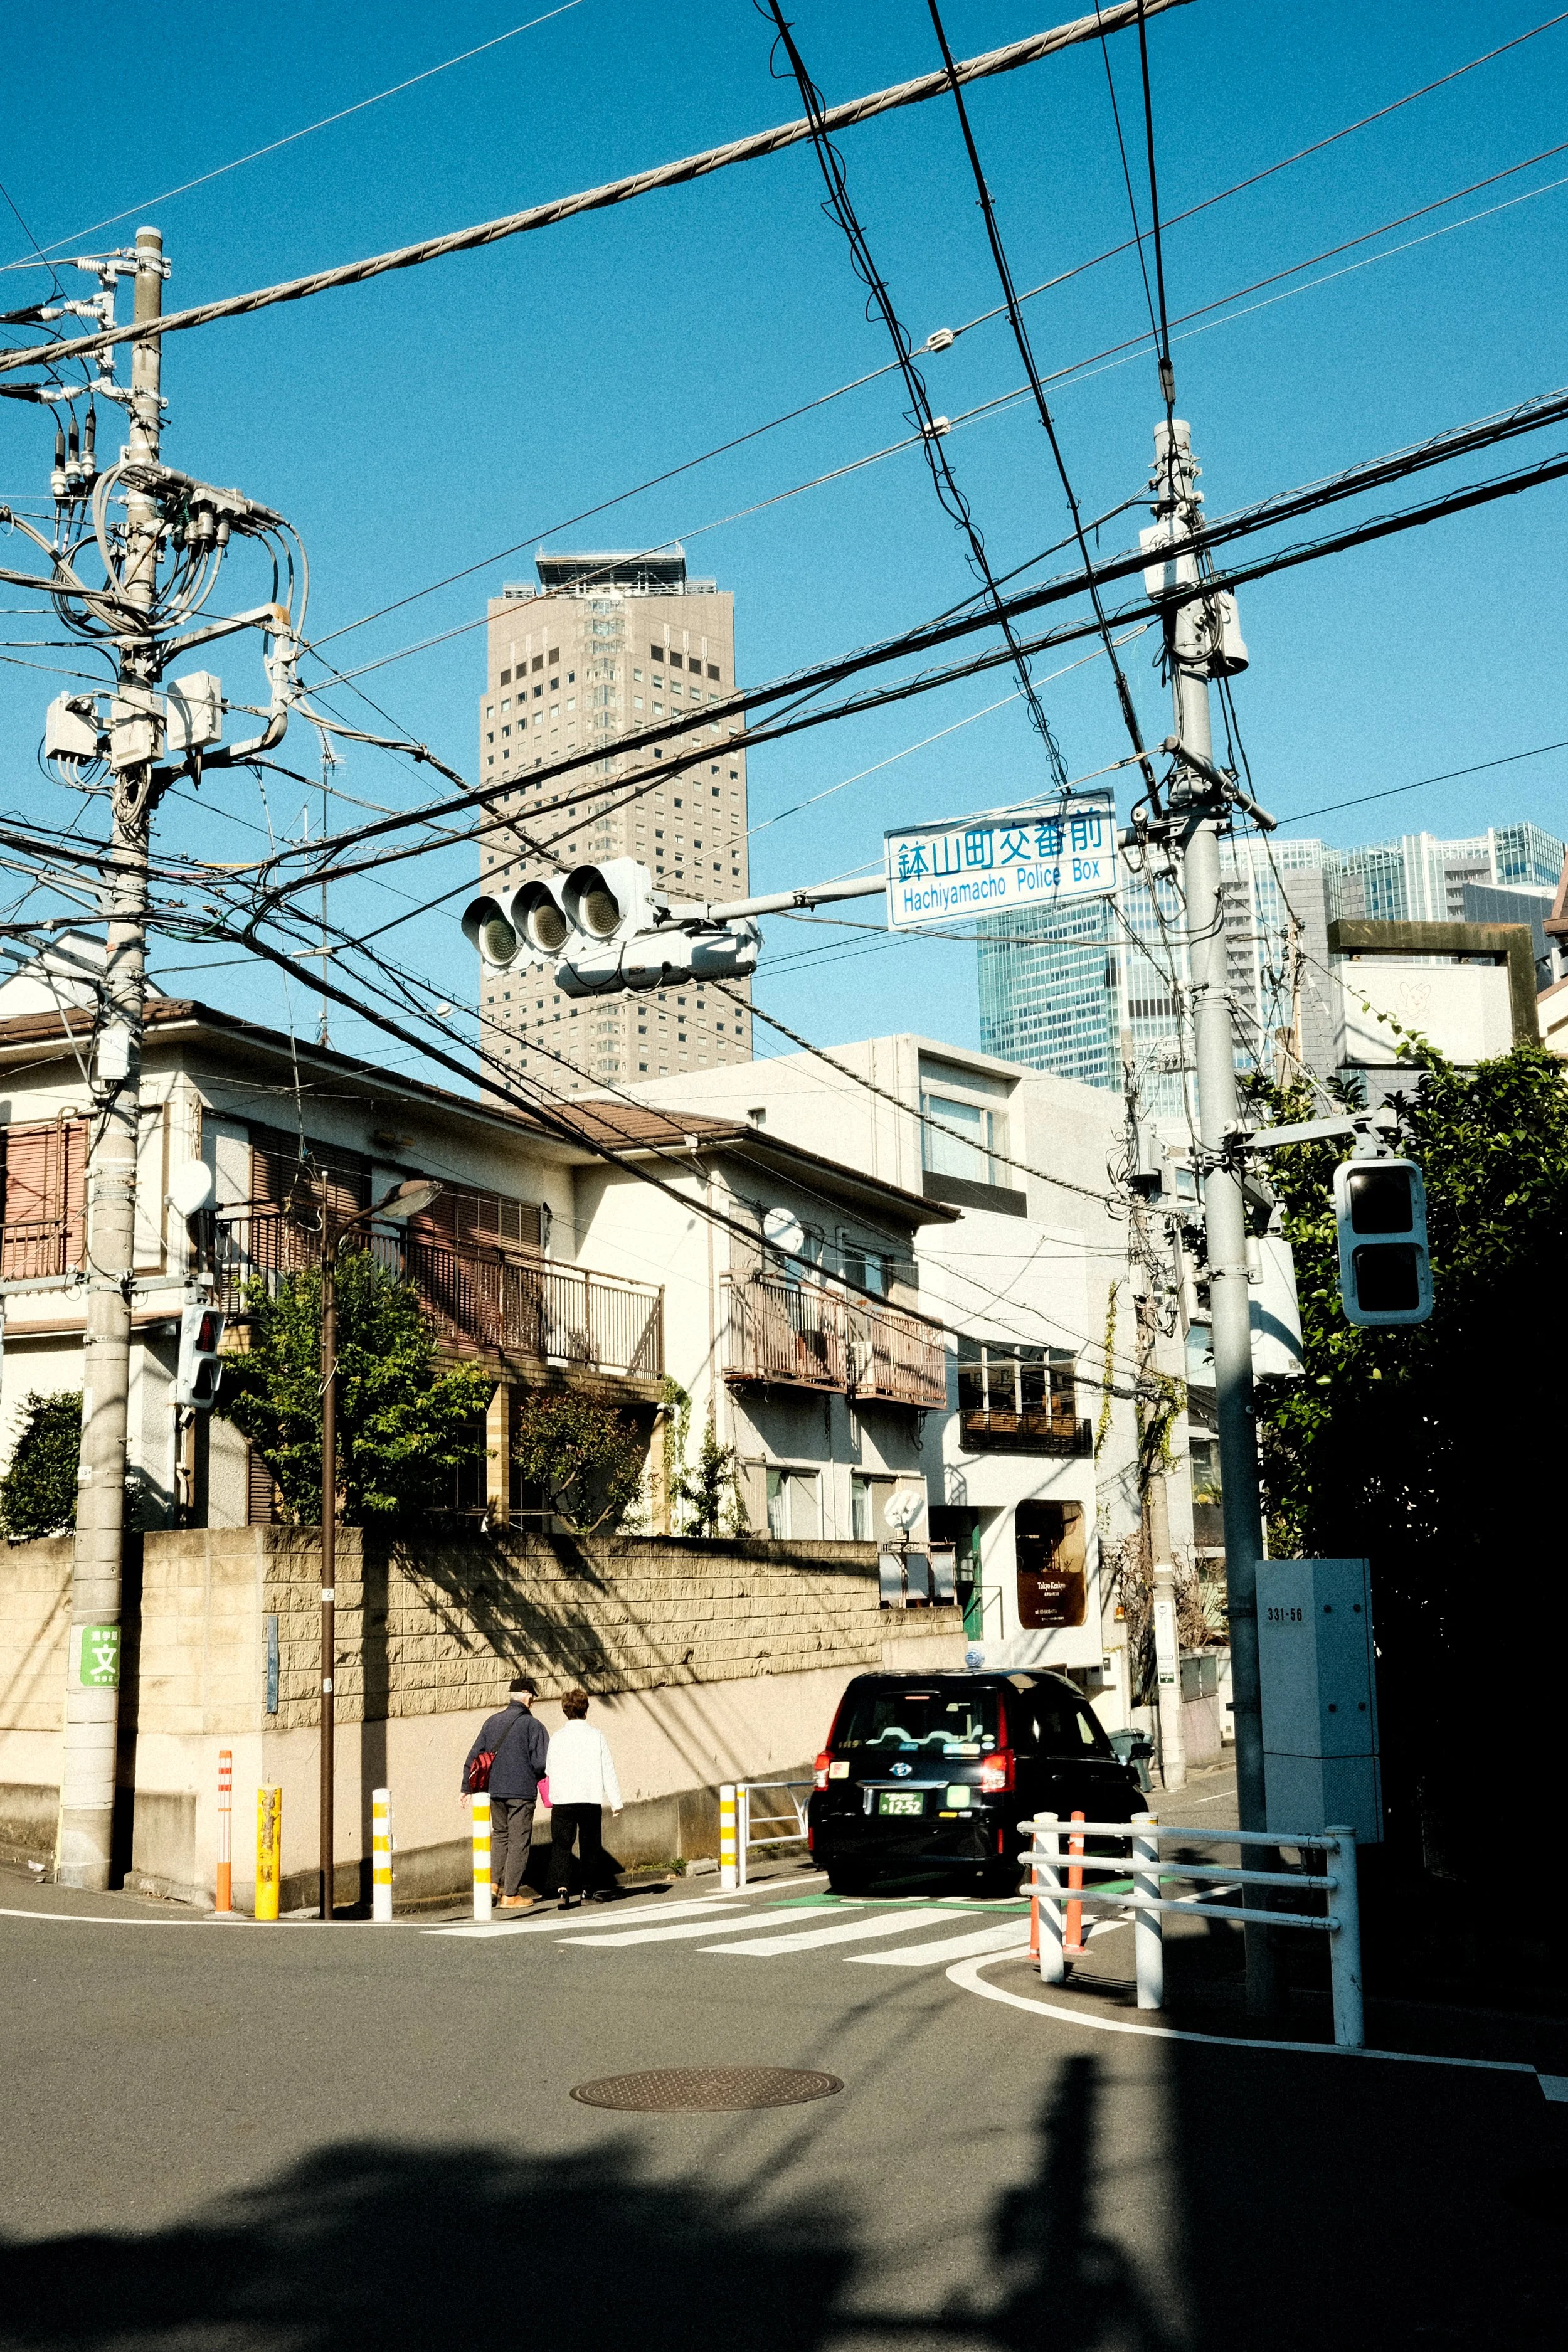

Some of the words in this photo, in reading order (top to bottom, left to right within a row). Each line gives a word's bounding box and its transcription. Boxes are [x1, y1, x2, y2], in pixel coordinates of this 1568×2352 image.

[898, 807, 1103, 883] 鉢山町交番前
[904, 874, 1006, 913] Hachiyamacho
[1017, 863, 1061, 892] Police
[1073, 857, 1101, 882] Box
[1037, 1581, 1051, 1591] Tokyo
[1268, 1607, 1302, 1621] 331-56
[90, 1643, 117, 1675] 文
[889, 1801, 921, 1814] 12-52
